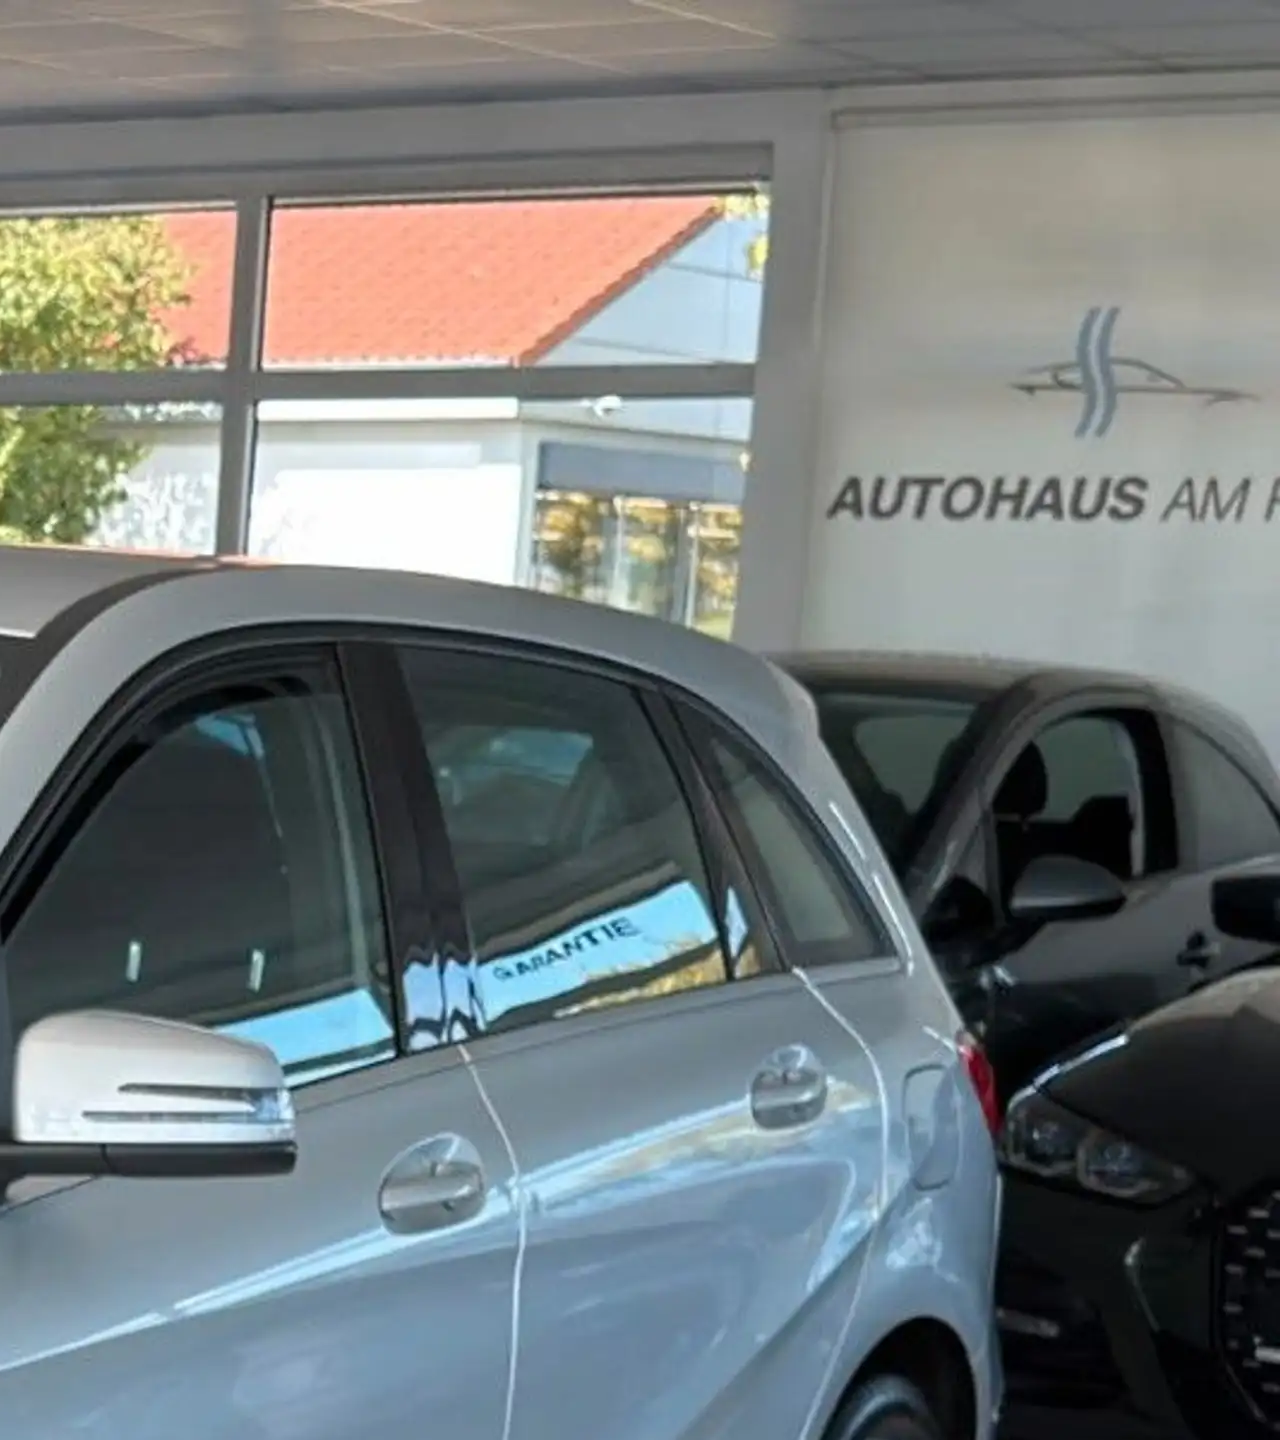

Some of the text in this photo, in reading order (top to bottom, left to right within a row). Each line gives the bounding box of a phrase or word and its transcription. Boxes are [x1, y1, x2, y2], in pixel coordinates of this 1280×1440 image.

[826, 476, 1150, 521] AUTOHAUS
[1160, 477, 1251, 521] AM
[491, 915, 642, 982] GARANTIE
